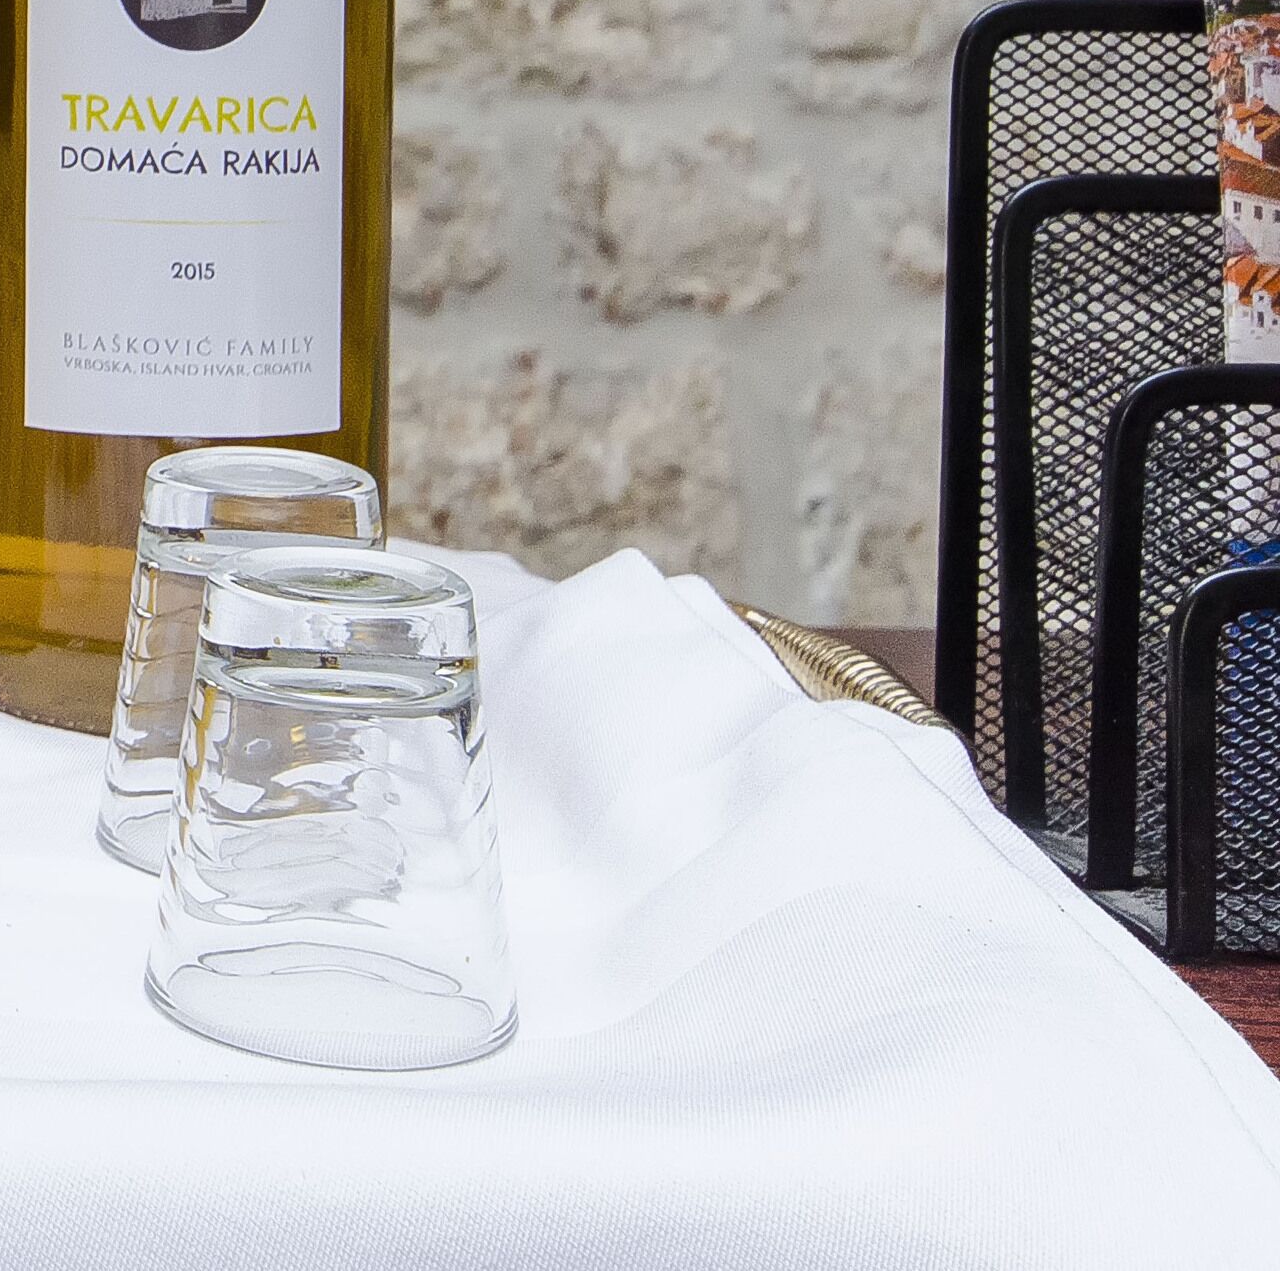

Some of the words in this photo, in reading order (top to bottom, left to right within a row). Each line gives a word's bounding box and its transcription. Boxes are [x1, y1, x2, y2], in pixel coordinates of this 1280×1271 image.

[60, 93, 318, 134] TRAVARICA
[60, 141, 208, 175] DOMAĆA
[223, 146, 320, 176] RAKIJA
[170, 261, 216, 280] 2015
[63, 332, 213, 357] BLAŠKOVIĆ
[226, 335, 315, 357] FAMILY
[140, 362, 199, 377] ISLAND
[252, 360, 313, 377] CROATIA
